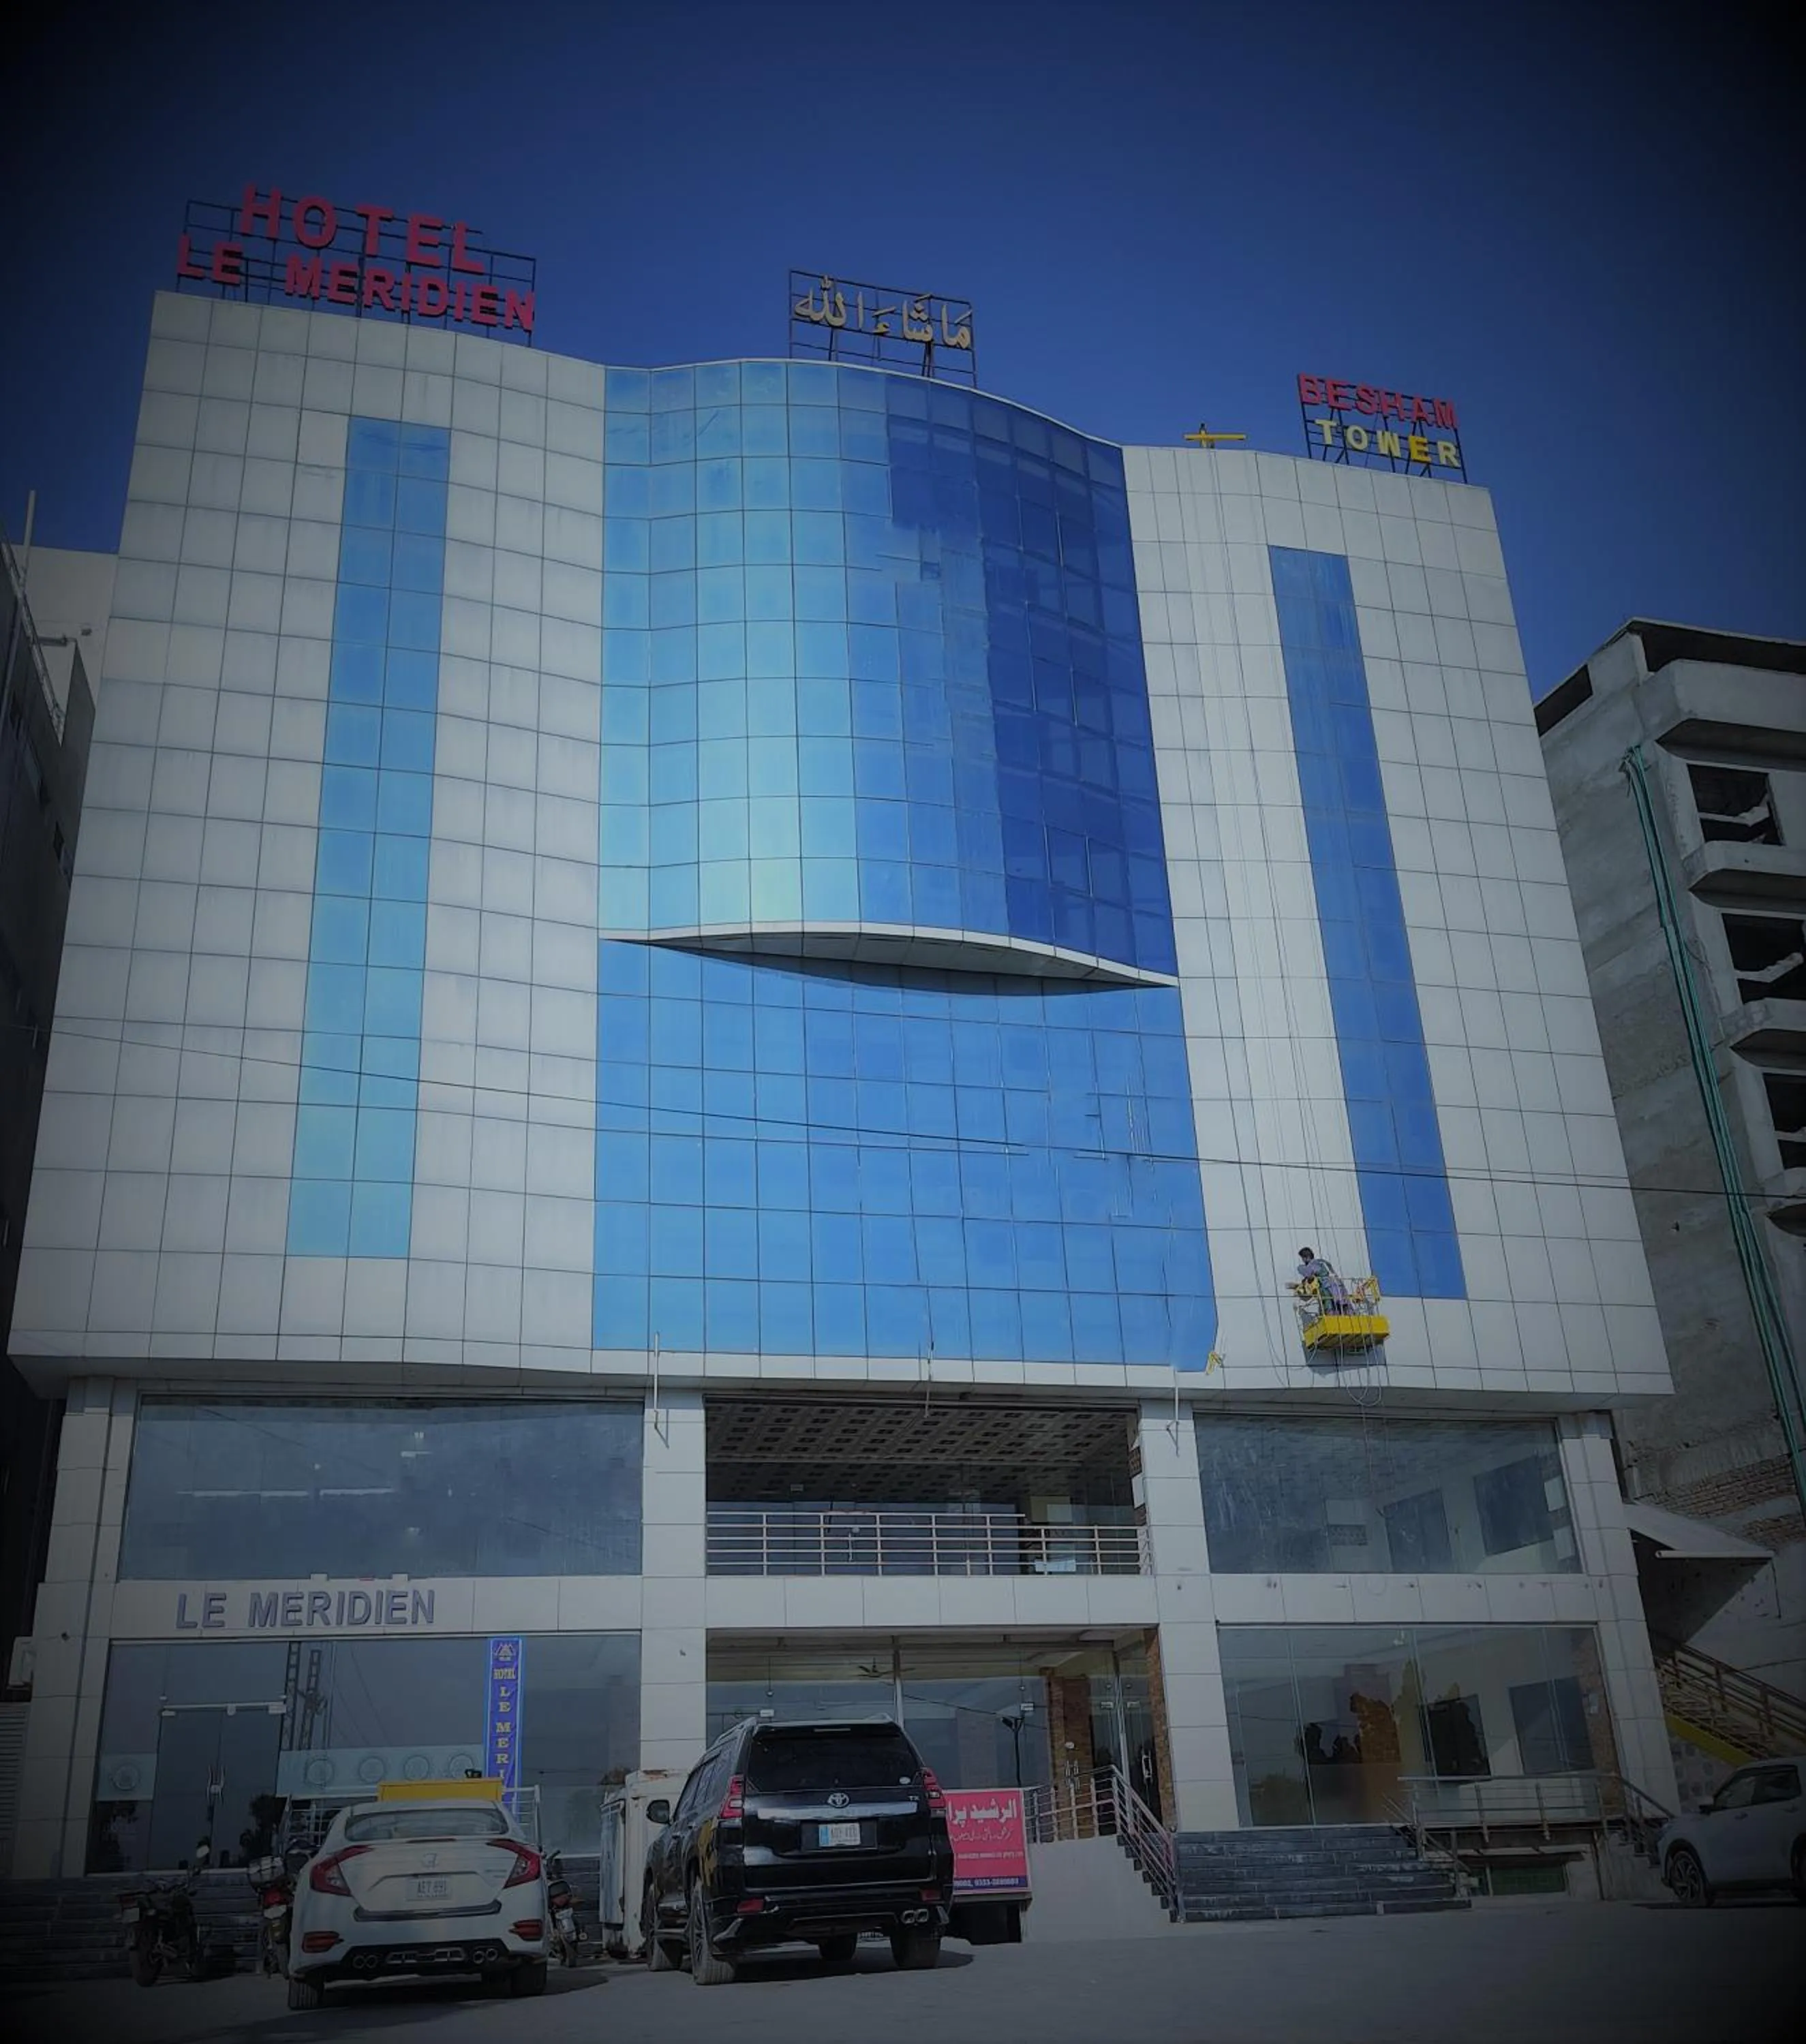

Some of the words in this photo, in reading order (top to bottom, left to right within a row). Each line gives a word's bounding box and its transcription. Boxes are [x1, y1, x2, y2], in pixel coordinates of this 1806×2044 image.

[239, 184, 485, 274] HOTEL
[177, 232, 243, 285] LE
[284, 253, 535, 332] MERIDIEN
[1298, 372, 1459, 430] BESHAM
[1315, 419, 1462, 468] TOWER
[176, 1592, 227, 1629] LE
[248, 1590, 435, 1627] MERIDIEN
